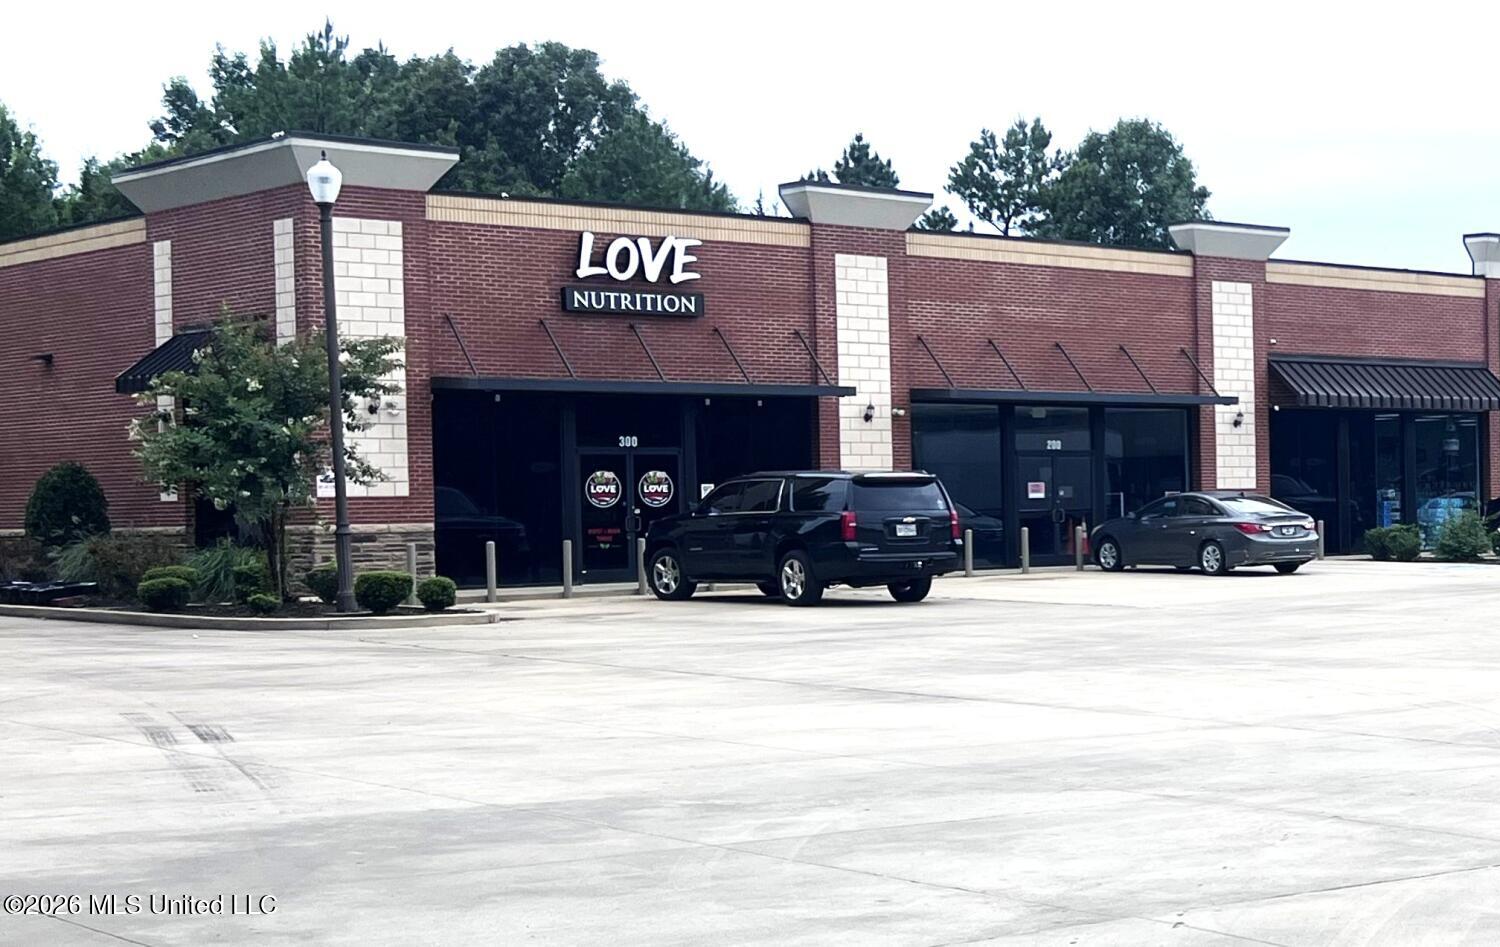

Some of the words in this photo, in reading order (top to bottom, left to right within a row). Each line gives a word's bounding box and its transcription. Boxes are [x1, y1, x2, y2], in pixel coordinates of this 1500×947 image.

[576, 231, 703, 284] LOVE
[573, 290, 696, 313] NUTRITION
[618, 436, 638, 447] 300
[590, 485, 616, 493] LOVE
[643, 485, 669, 493] LOVE
